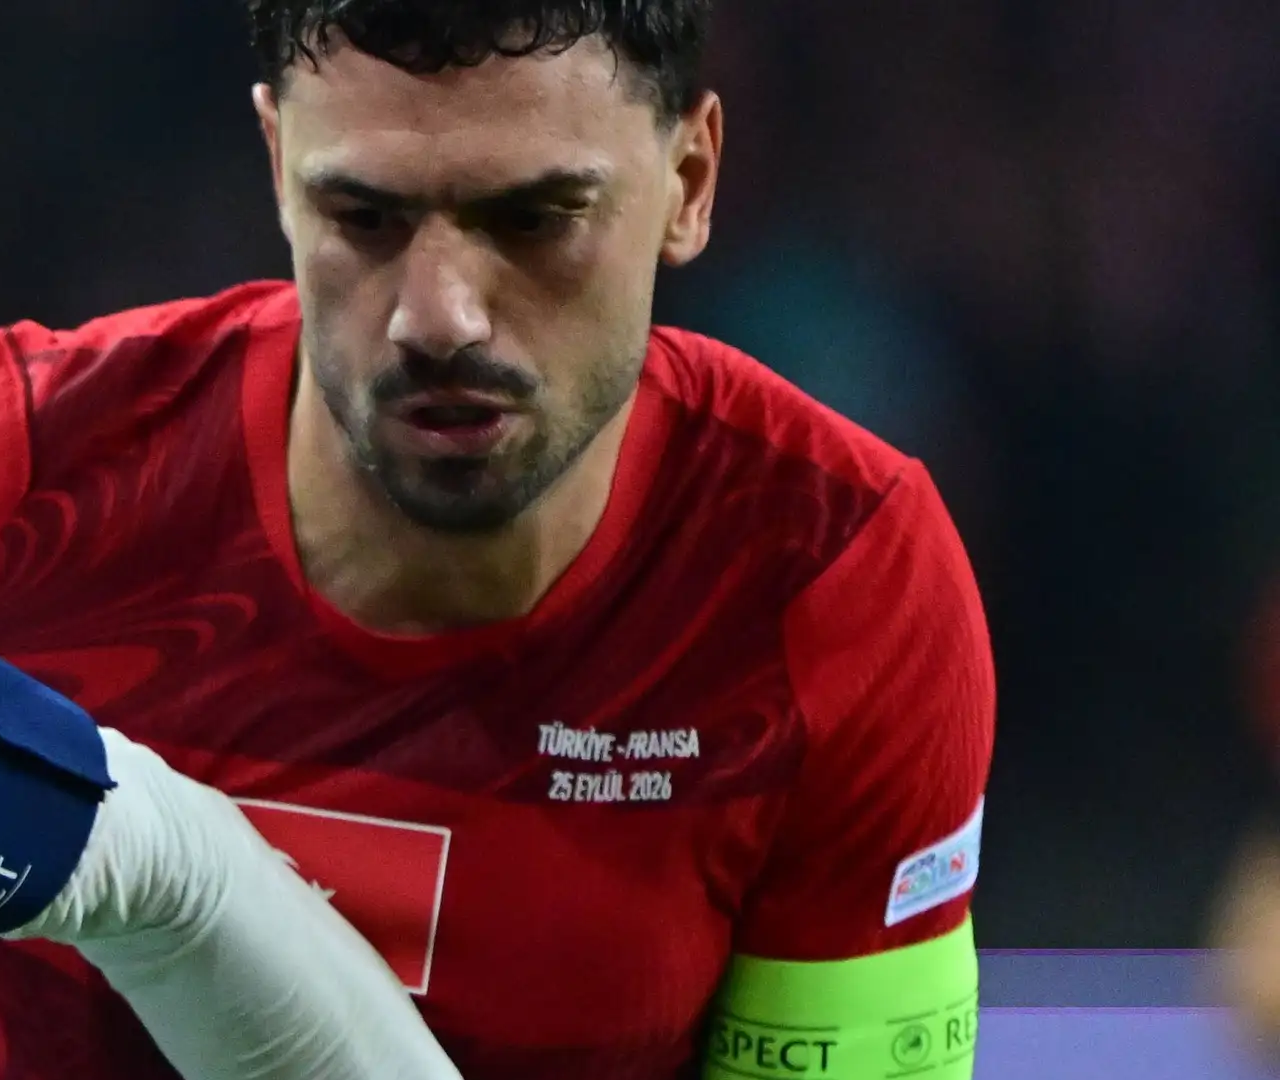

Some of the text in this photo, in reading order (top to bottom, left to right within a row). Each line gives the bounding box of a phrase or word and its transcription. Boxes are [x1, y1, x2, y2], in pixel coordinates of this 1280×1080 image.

[548, 769, 672, 802] 25 EYLÜL 2026
